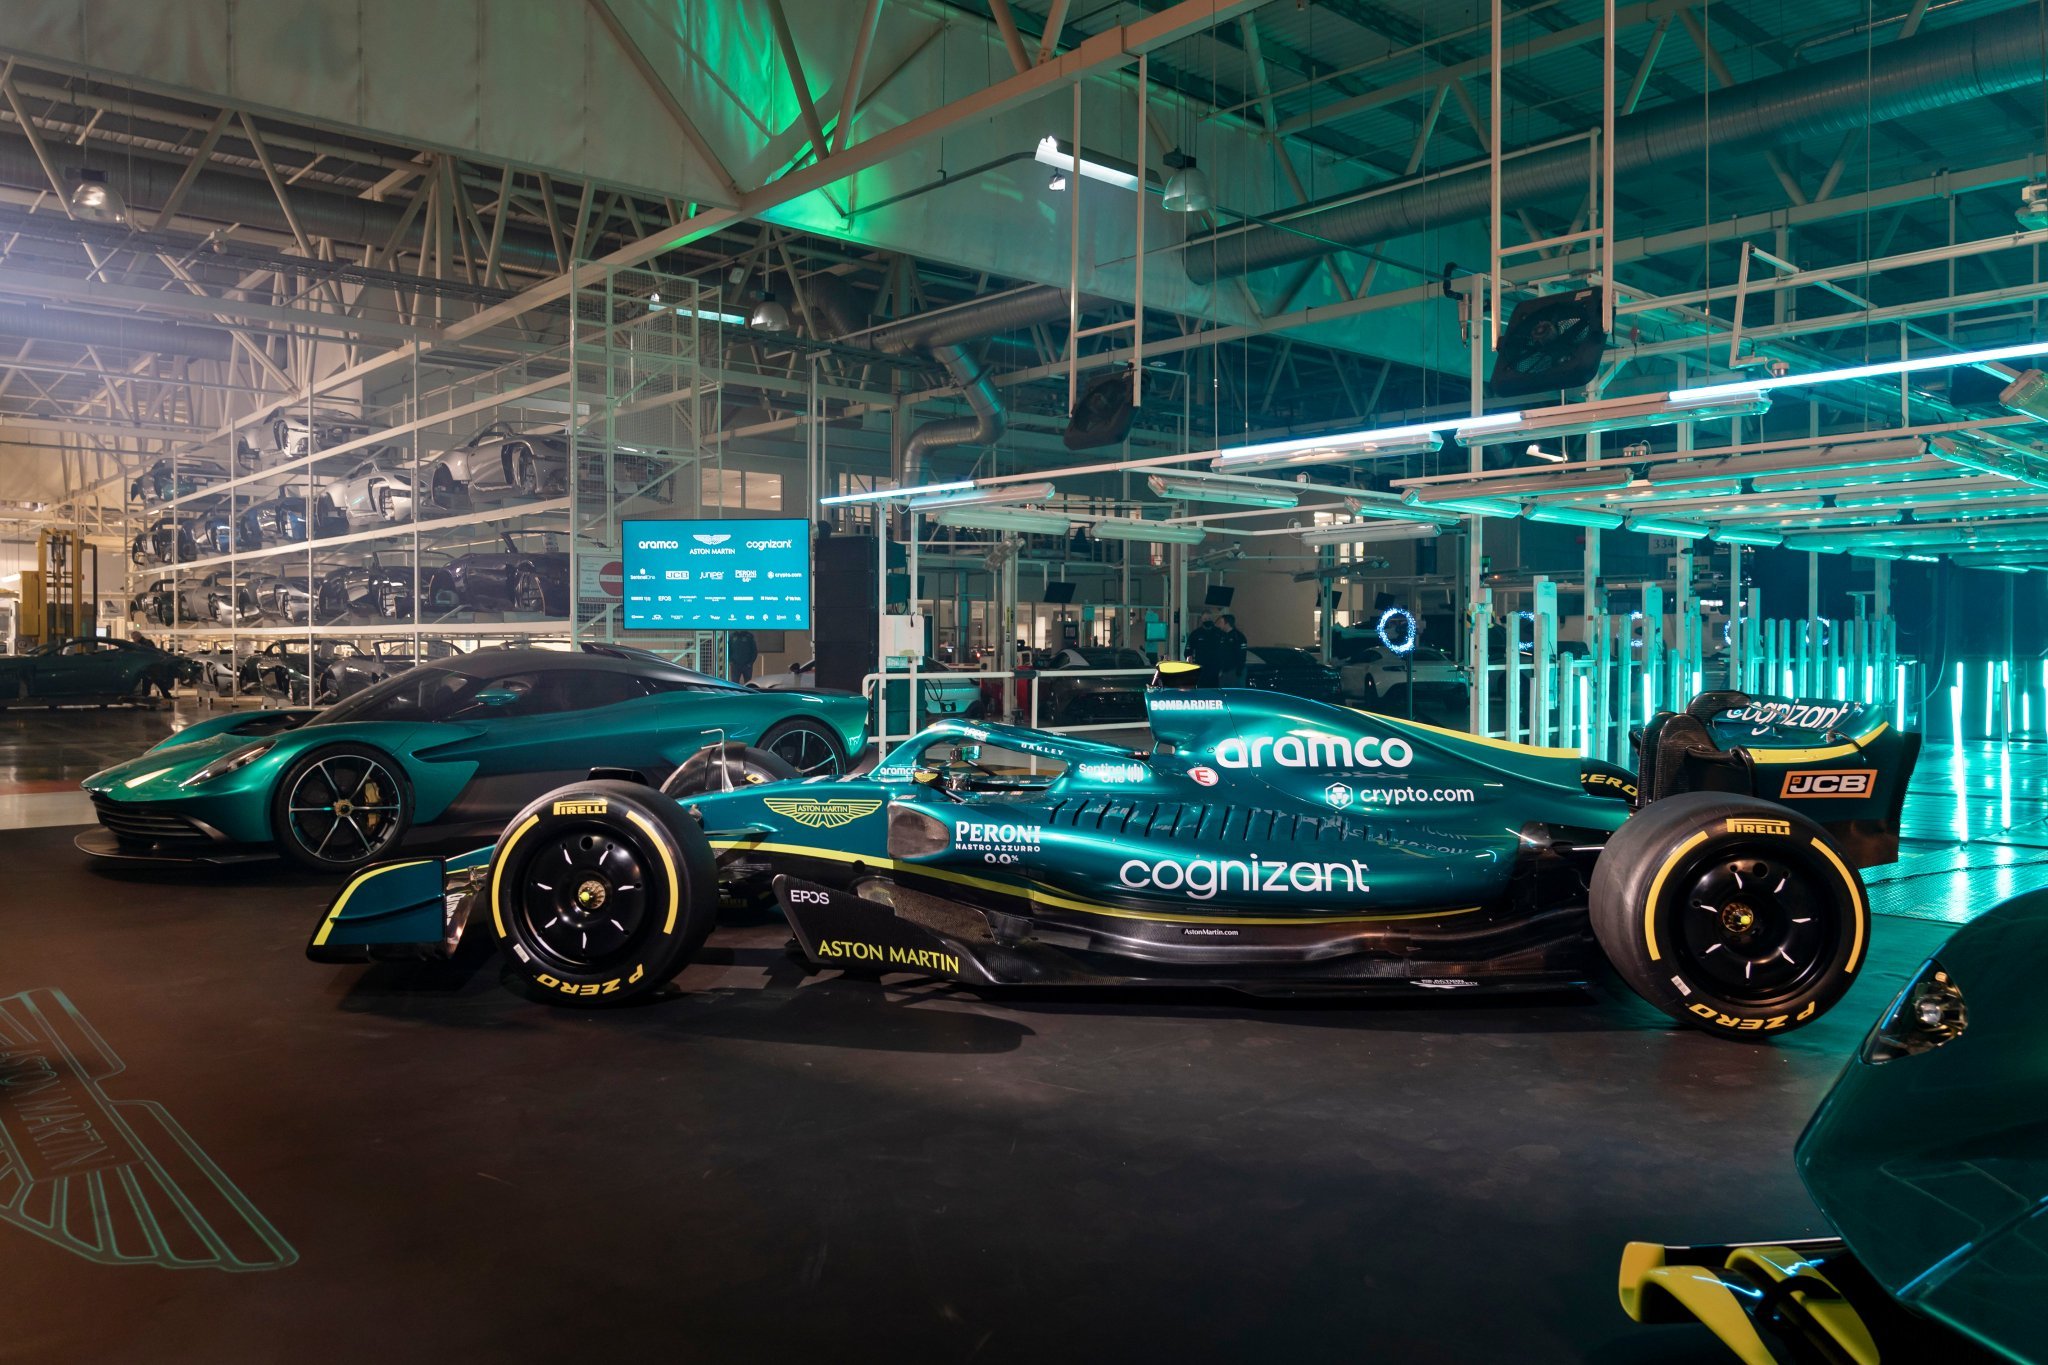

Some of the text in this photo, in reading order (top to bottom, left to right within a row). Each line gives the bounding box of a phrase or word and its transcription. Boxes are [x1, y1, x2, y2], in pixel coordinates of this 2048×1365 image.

[638, 540, 678, 549] aramco
[746, 539, 792, 551] cognizant
[666, 571, 688, 579] JCB
[1150, 700, 1224, 710] BOMBARDIER
[1021, 743, 1064, 756] OAKLEY
[1215, 736, 1414, 768] aramco
[1079, 763, 1125, 775] Sentinel
[1101, 774, 1125, 783] One
[1195, 770, 1210, 783] E
[1790, 775, 1867, 793] JCB
[1360, 786, 1475, 806] crypto.com
[553, 800, 608, 816] PIRELLI
[822, 805, 848, 813] MARTIN
[955, 821, 1041, 843] PERONI
[1726, 818, 1791, 836] PIRELLI
[955, 843, 992, 851] NASTRO
[984, 853, 1019, 864] 0.0%
[1119, 853, 1370, 900] cognizant
[790, 889, 830, 905] EPOS
[1184, 928, 1239, 936] AstonMartin.com
[818, 940, 960, 974] ASTON MARTIN
[536, 963, 645, 996] P ZERO
[1688, 1000, 1816, 1030] P ZERO
